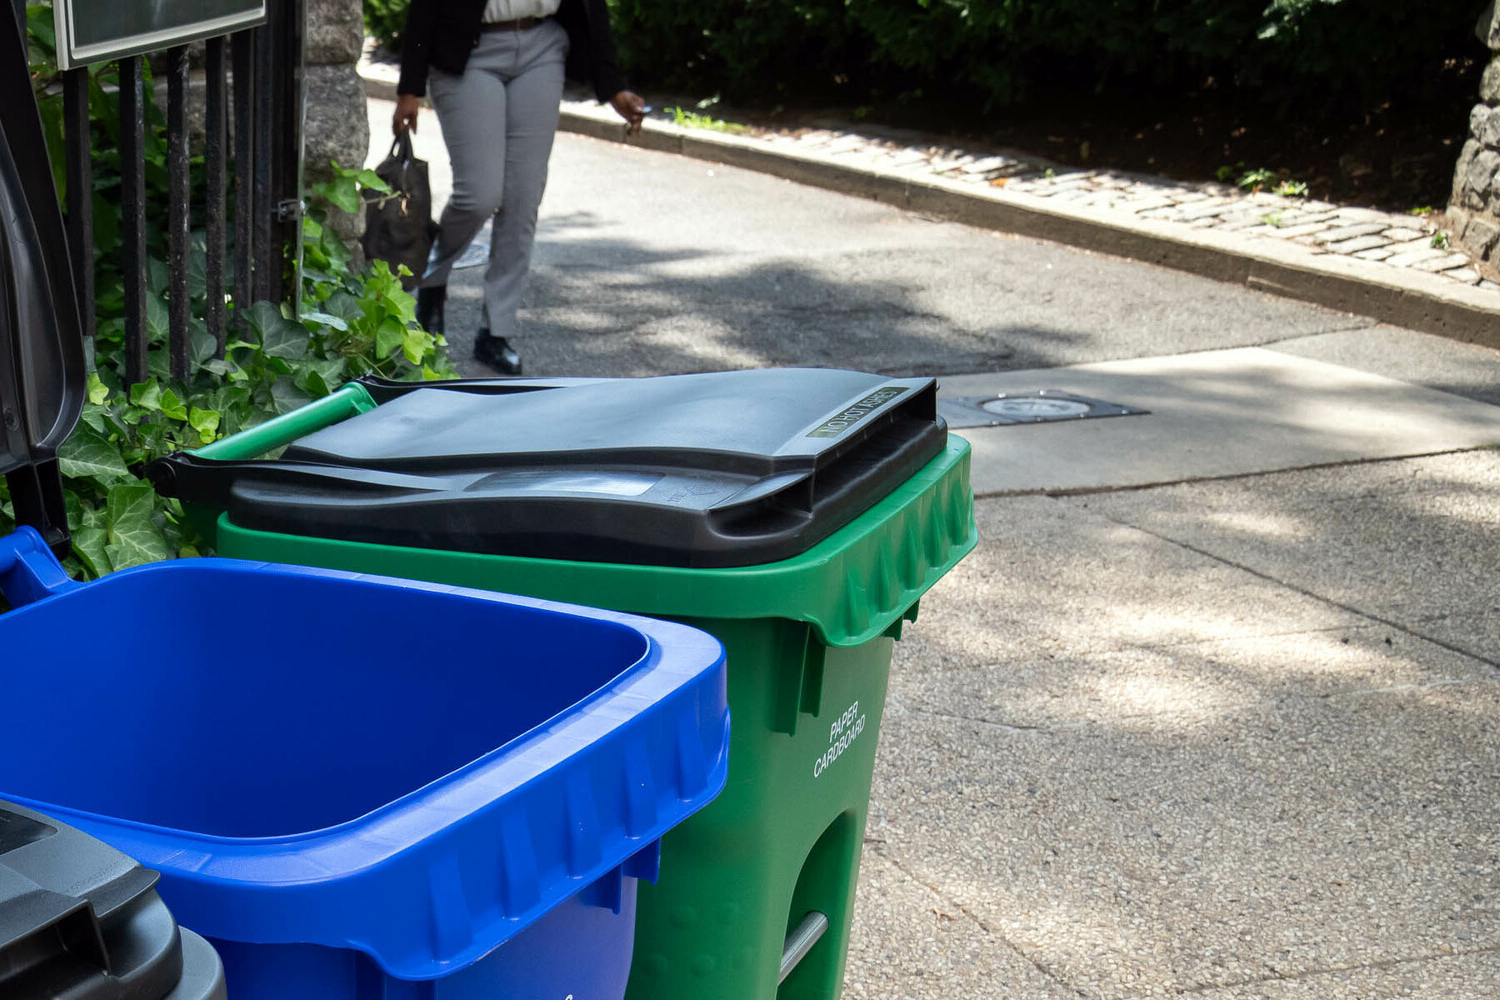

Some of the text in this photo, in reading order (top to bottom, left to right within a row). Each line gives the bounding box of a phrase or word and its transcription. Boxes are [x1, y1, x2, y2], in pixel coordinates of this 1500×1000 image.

[819, 391, 898, 433] NO HOT ASHES
[829, 700, 859, 743] PAPER
[813, 714, 866, 778] CARDBOARD
